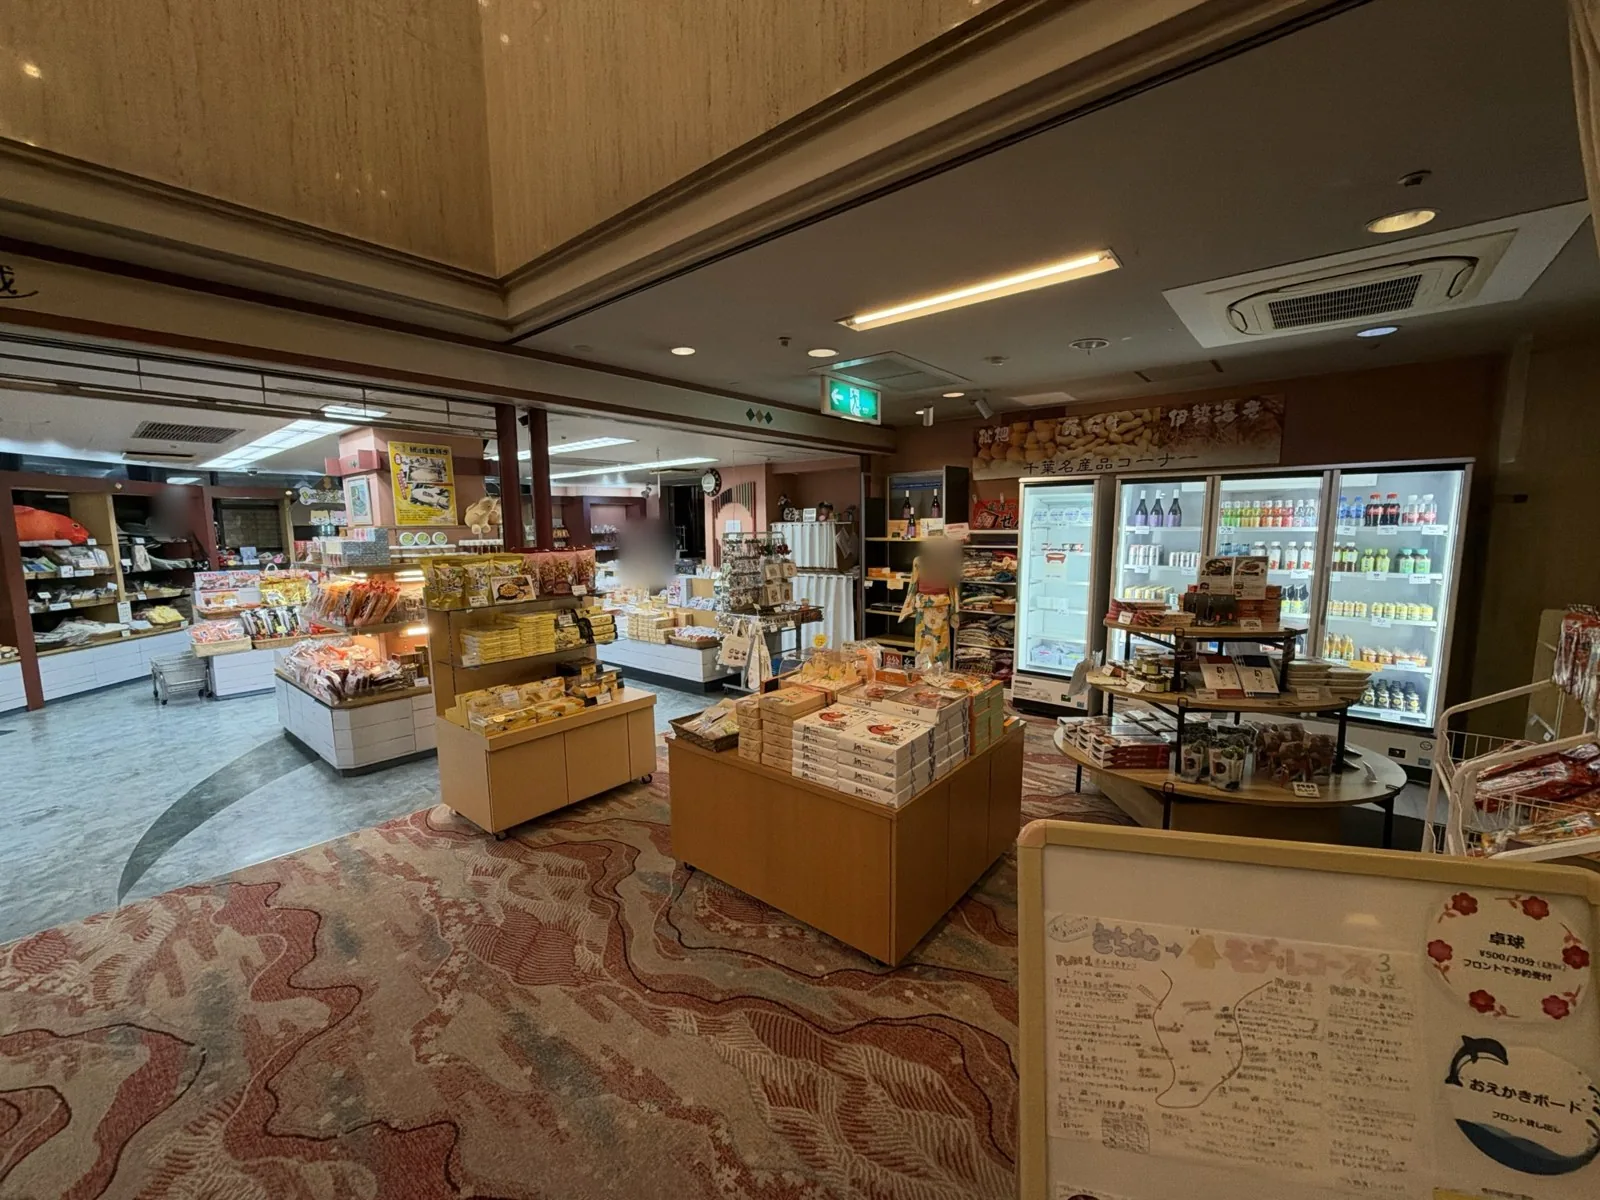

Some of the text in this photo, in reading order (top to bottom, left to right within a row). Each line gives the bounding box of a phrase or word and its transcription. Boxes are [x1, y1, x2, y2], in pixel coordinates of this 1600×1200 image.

[1023, 452, 1199, 475] 千葉名産品コーナー
[1489, 931, 1526, 949] 卓球
[1463, 958, 1553, 982] フロントで予約受付
[1469, 1078, 1582, 1114] おえかきボード
[1492, 1111, 1562, 1134] フロント貸し出し
